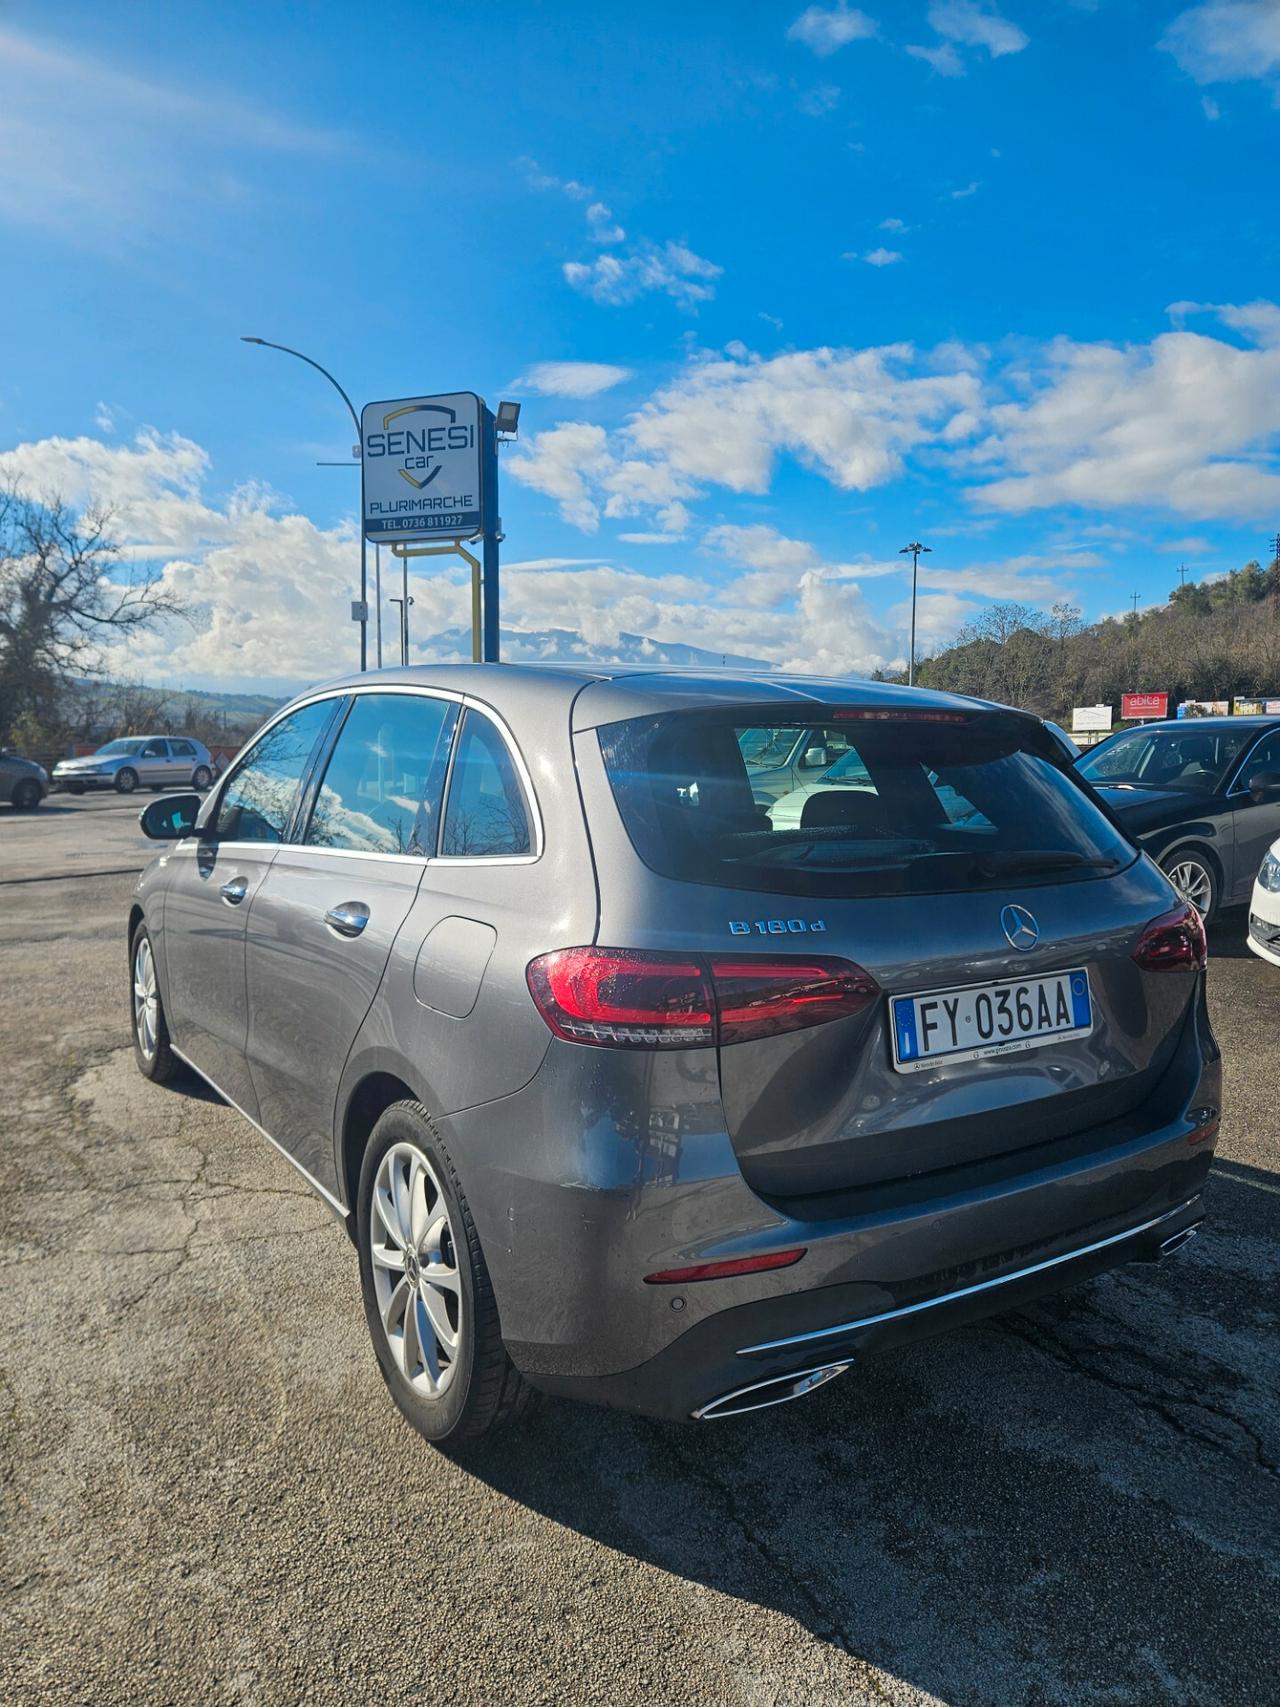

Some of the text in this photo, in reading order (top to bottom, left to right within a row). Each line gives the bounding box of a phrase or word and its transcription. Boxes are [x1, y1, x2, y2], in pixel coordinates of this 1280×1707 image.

[367, 424, 474, 457] SENESI
[404, 455, 434, 470] car
[370, 494, 473, 514] PLURIMARCHE
[382, 515, 463, 530] TEL. 0736 811927
[728, 919, 827, 936] B 180 d
[919, 981, 1071, 1052] FY 036AA
